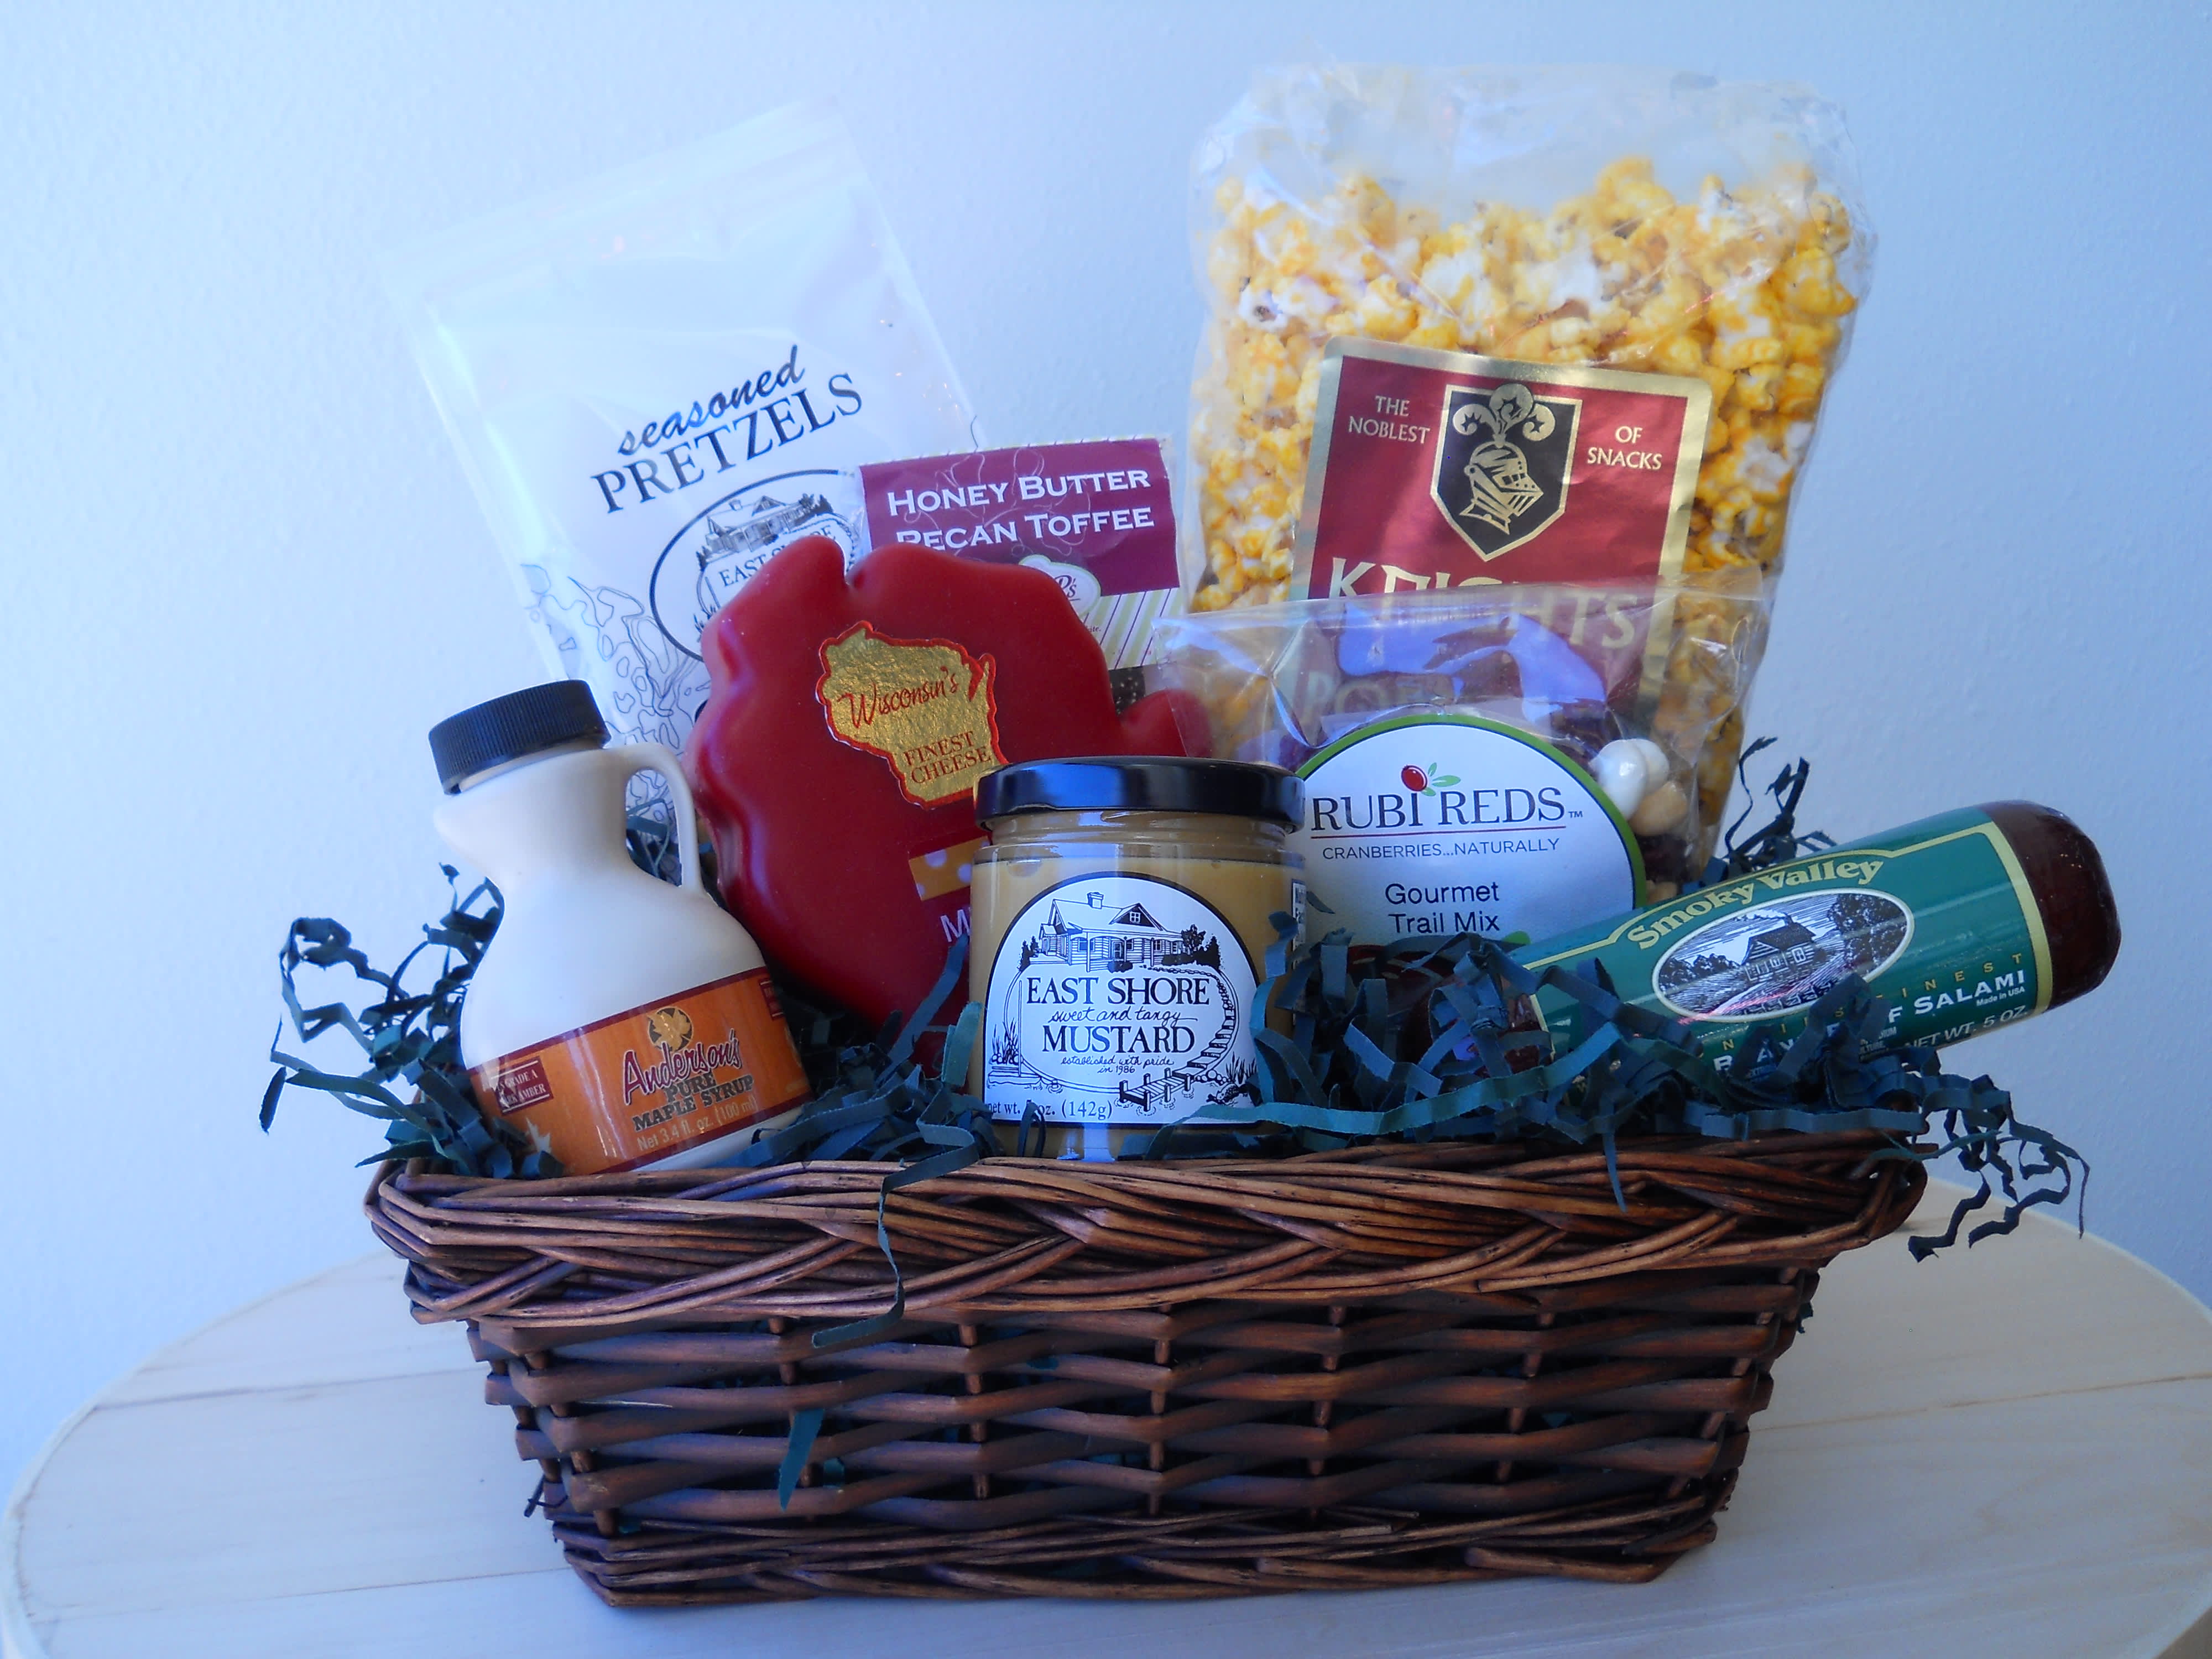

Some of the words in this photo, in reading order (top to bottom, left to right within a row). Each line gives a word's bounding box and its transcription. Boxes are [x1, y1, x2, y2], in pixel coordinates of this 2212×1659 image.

[618, 345, 805, 455] seasoned
[1375, 395, 1410, 416] THE
[590, 373, 862, 513] PRETZELS
[1348, 415, 1431, 444] NOBLEST
[1615, 425, 1643, 444] OF
[1587, 446, 1662, 470] SNACKS
[888, 482, 1009, 516] HONEY
[1018, 469, 1151, 500] BUTTER
[896, 521, 1018, 551] PECAN
[1024, 507, 1155, 539] TOFFEE
[718, 554, 766, 587] EAST
[837, 666, 959, 728] Wisconsin's
[904, 731, 974, 766] FINEST
[911, 745, 992, 785] CHEESE
[1439, 787, 1566, 825] REDS
[1385, 881, 1499, 905] Gourmet
[1627, 883, 1755, 950] Smoky
[1757, 859, 1884, 890] Valley
[1388, 912, 1444, 933] Trail
[1455, 911, 1500, 932] Mix
[1026, 977, 1099, 1005] EAST
[1107, 977, 1210, 1005] SHORE
[1876, 953, 2022, 999] INEST
[1914, 969, 2025, 1015] SALAMI
[1976, 995, 1998, 1006] Made
[2008, 986, 2026, 997] USA
[1048, 1006, 1095, 1023] sweet
[1096, 1006, 1133, 1022] and
[1135, 1006, 1198, 1027] tangy
[1944, 1021, 1978, 1041] WT.
[1983, 1015, 1996, 1028] 5
[1999, 1005, 2028, 1022] OZ.
[1043, 1025, 1195, 1053] MUSTARD
[623, 1028, 742, 1105] Anderson's
[1061, 1055, 1115, 1065] established
[1119, 1056, 1141, 1066] with
[1142, 1056, 1175, 1069] pride
[1116, 1065, 1135, 1075] 1986
[504, 1071, 531, 1088] GRADE
[531, 1069, 539, 1078] A
[518, 1083, 546, 1101] AMBER
[665, 1071, 716, 1102] PURE
[632, 1096, 698, 1132] MAPLE
[701, 1074, 754, 1107] SYRUP
[1004, 1104, 1020, 1114] wt.
[1039, 1105, 1056, 1115] oz.
[1061, 1099, 1113, 1120] (142g)
[637, 1134, 659, 1151] Net
[660, 1125, 680, 1143] 3.4
